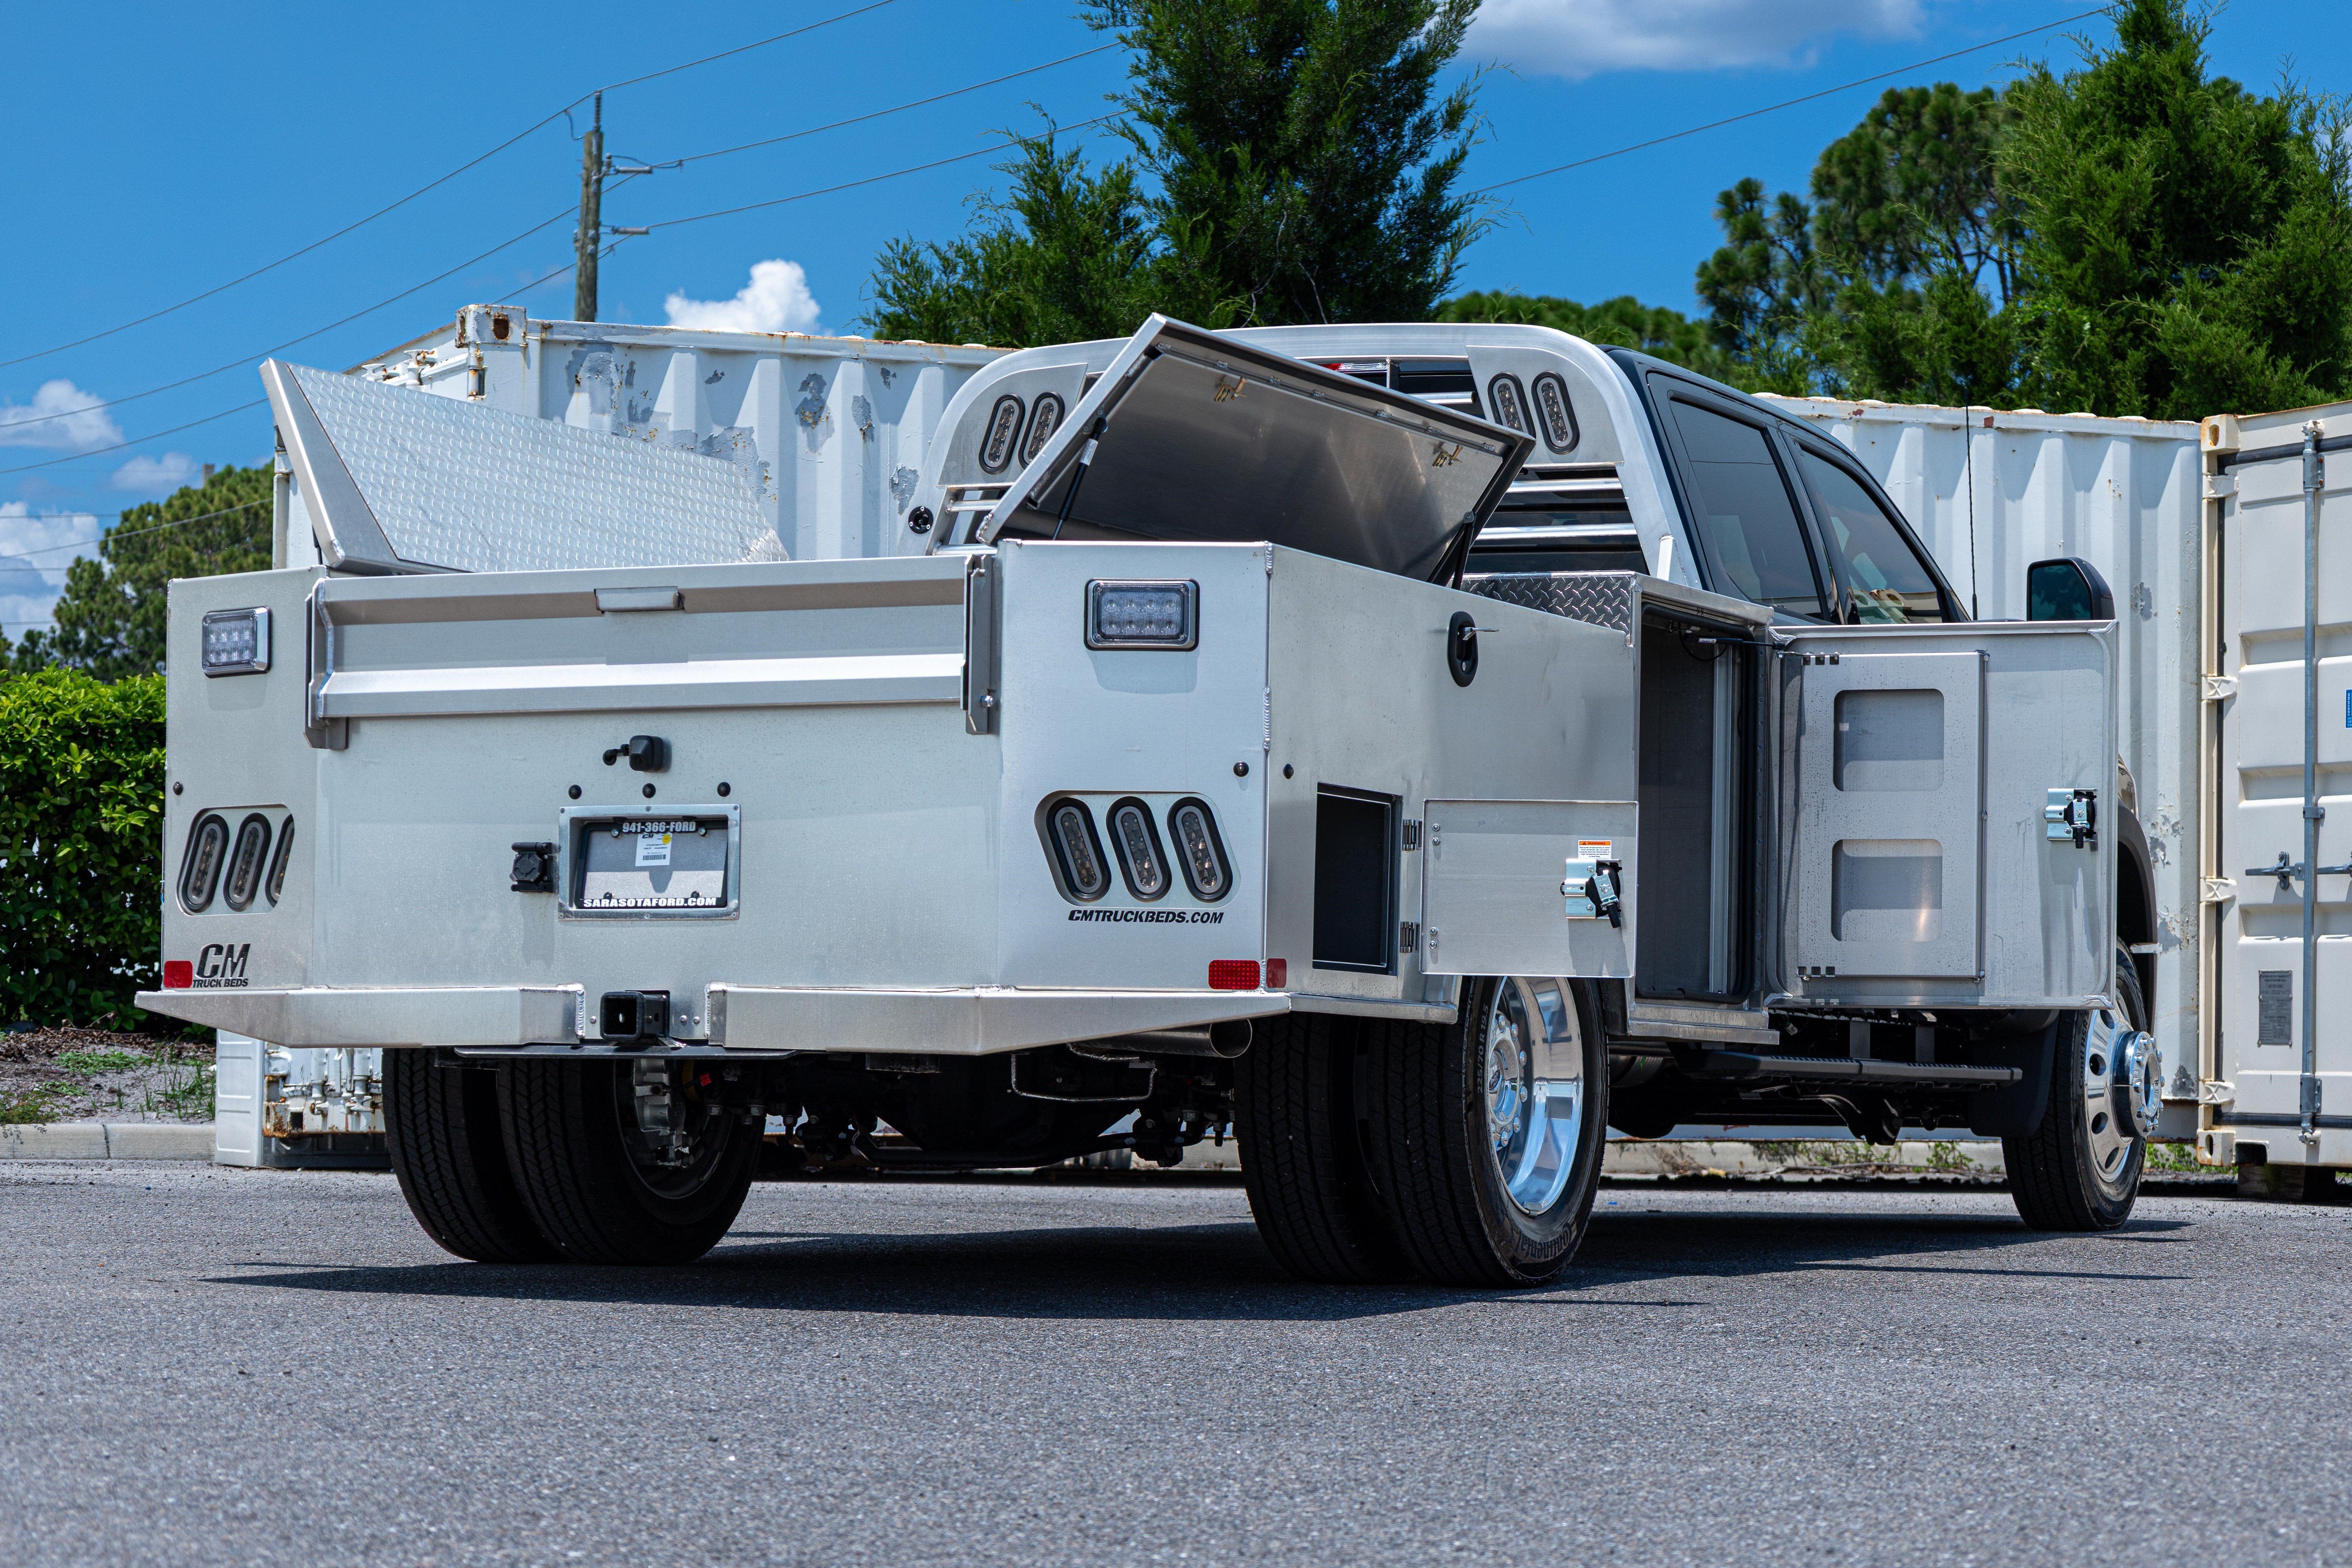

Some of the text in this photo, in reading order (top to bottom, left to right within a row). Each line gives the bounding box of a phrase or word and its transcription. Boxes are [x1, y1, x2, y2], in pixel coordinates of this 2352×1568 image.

[622, 822, 696, 832] 941-366-FORD
[584, 898, 717, 907] SARASOTAFORD.COM
[1068, 909, 1224, 924] CMTRUCKBEDS.COM
[195, 943, 251, 979] CM
[193, 978, 249, 988] TRUCK BEDS
[1481, 1004, 1489, 1030] 19.5
[1479, 1033, 1485, 1043] R
[1515, 1223, 1572, 1259] Continental
